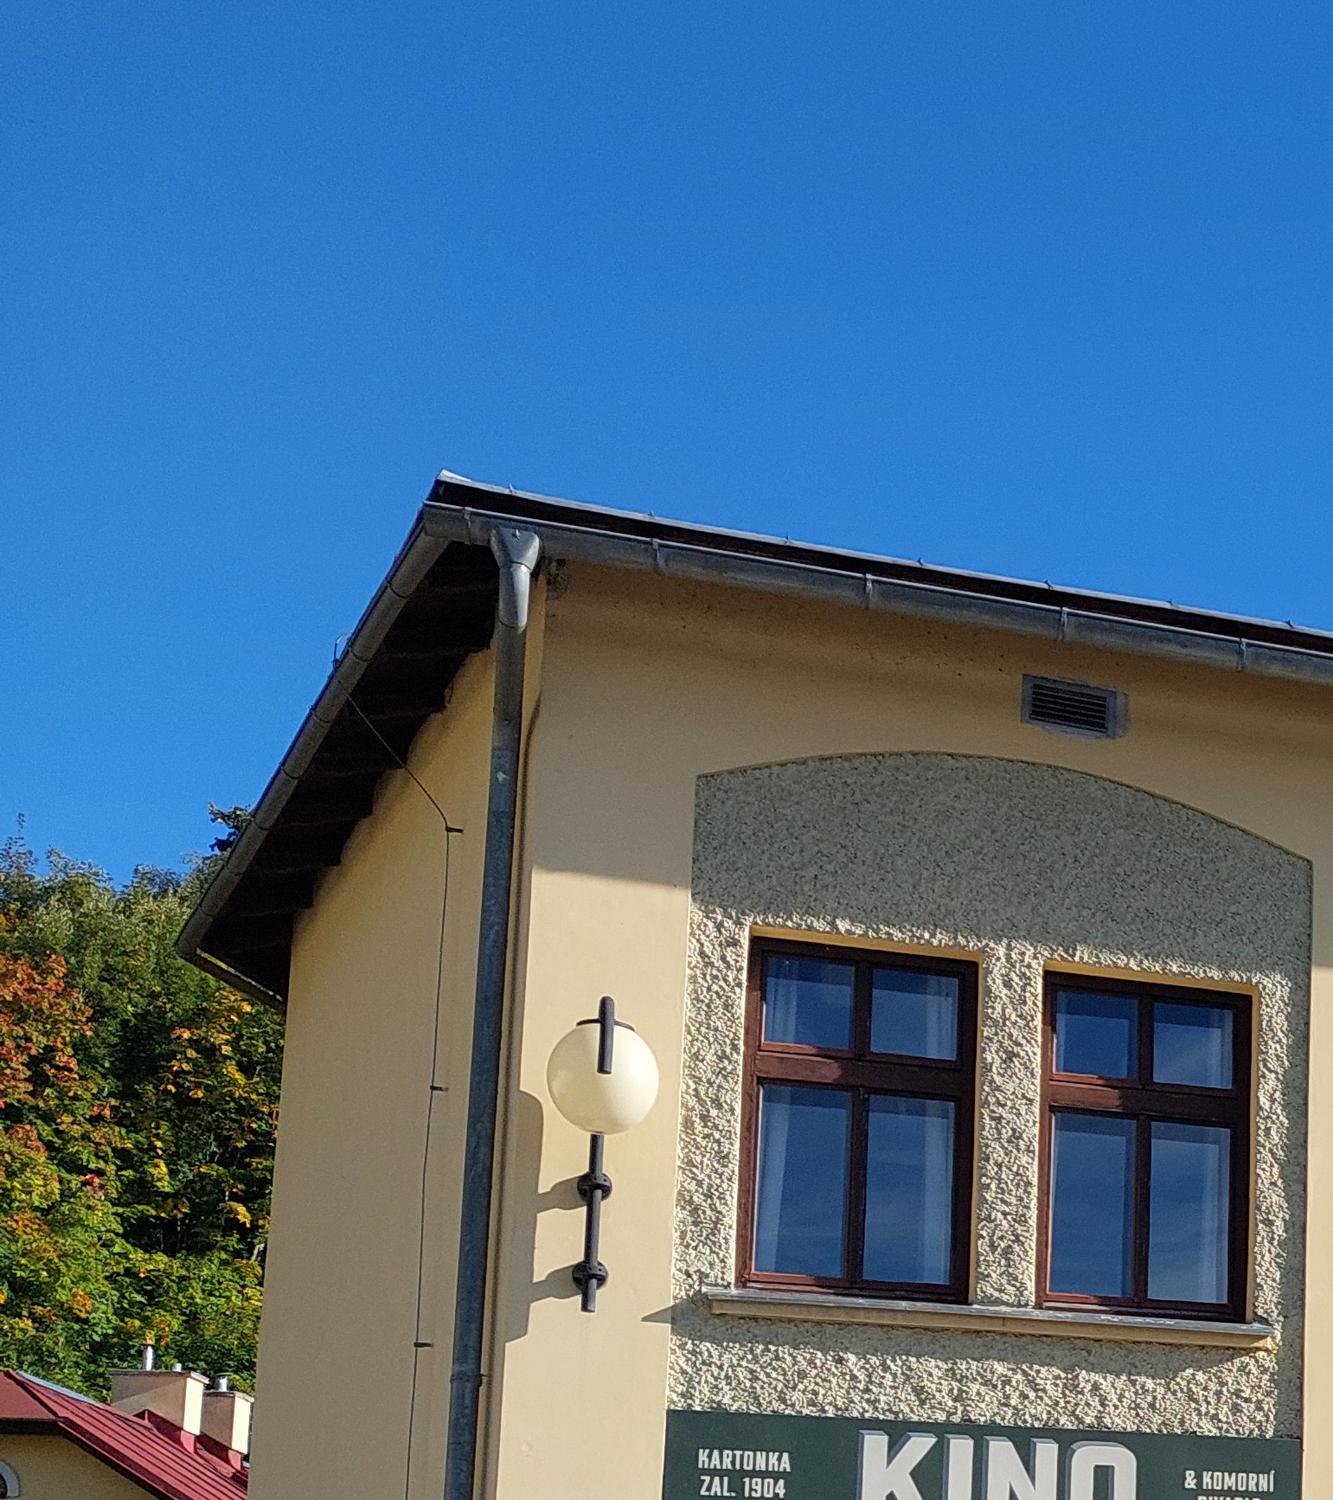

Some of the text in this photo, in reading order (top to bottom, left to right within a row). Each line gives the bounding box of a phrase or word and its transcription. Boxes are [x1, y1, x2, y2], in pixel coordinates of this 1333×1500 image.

[698, 1448, 791, 1472] KARTONKA
[700, 1475, 786, 1499] ZAL. 1904
[1184, 1469, 1275, 1492] & KOMORNÍ
